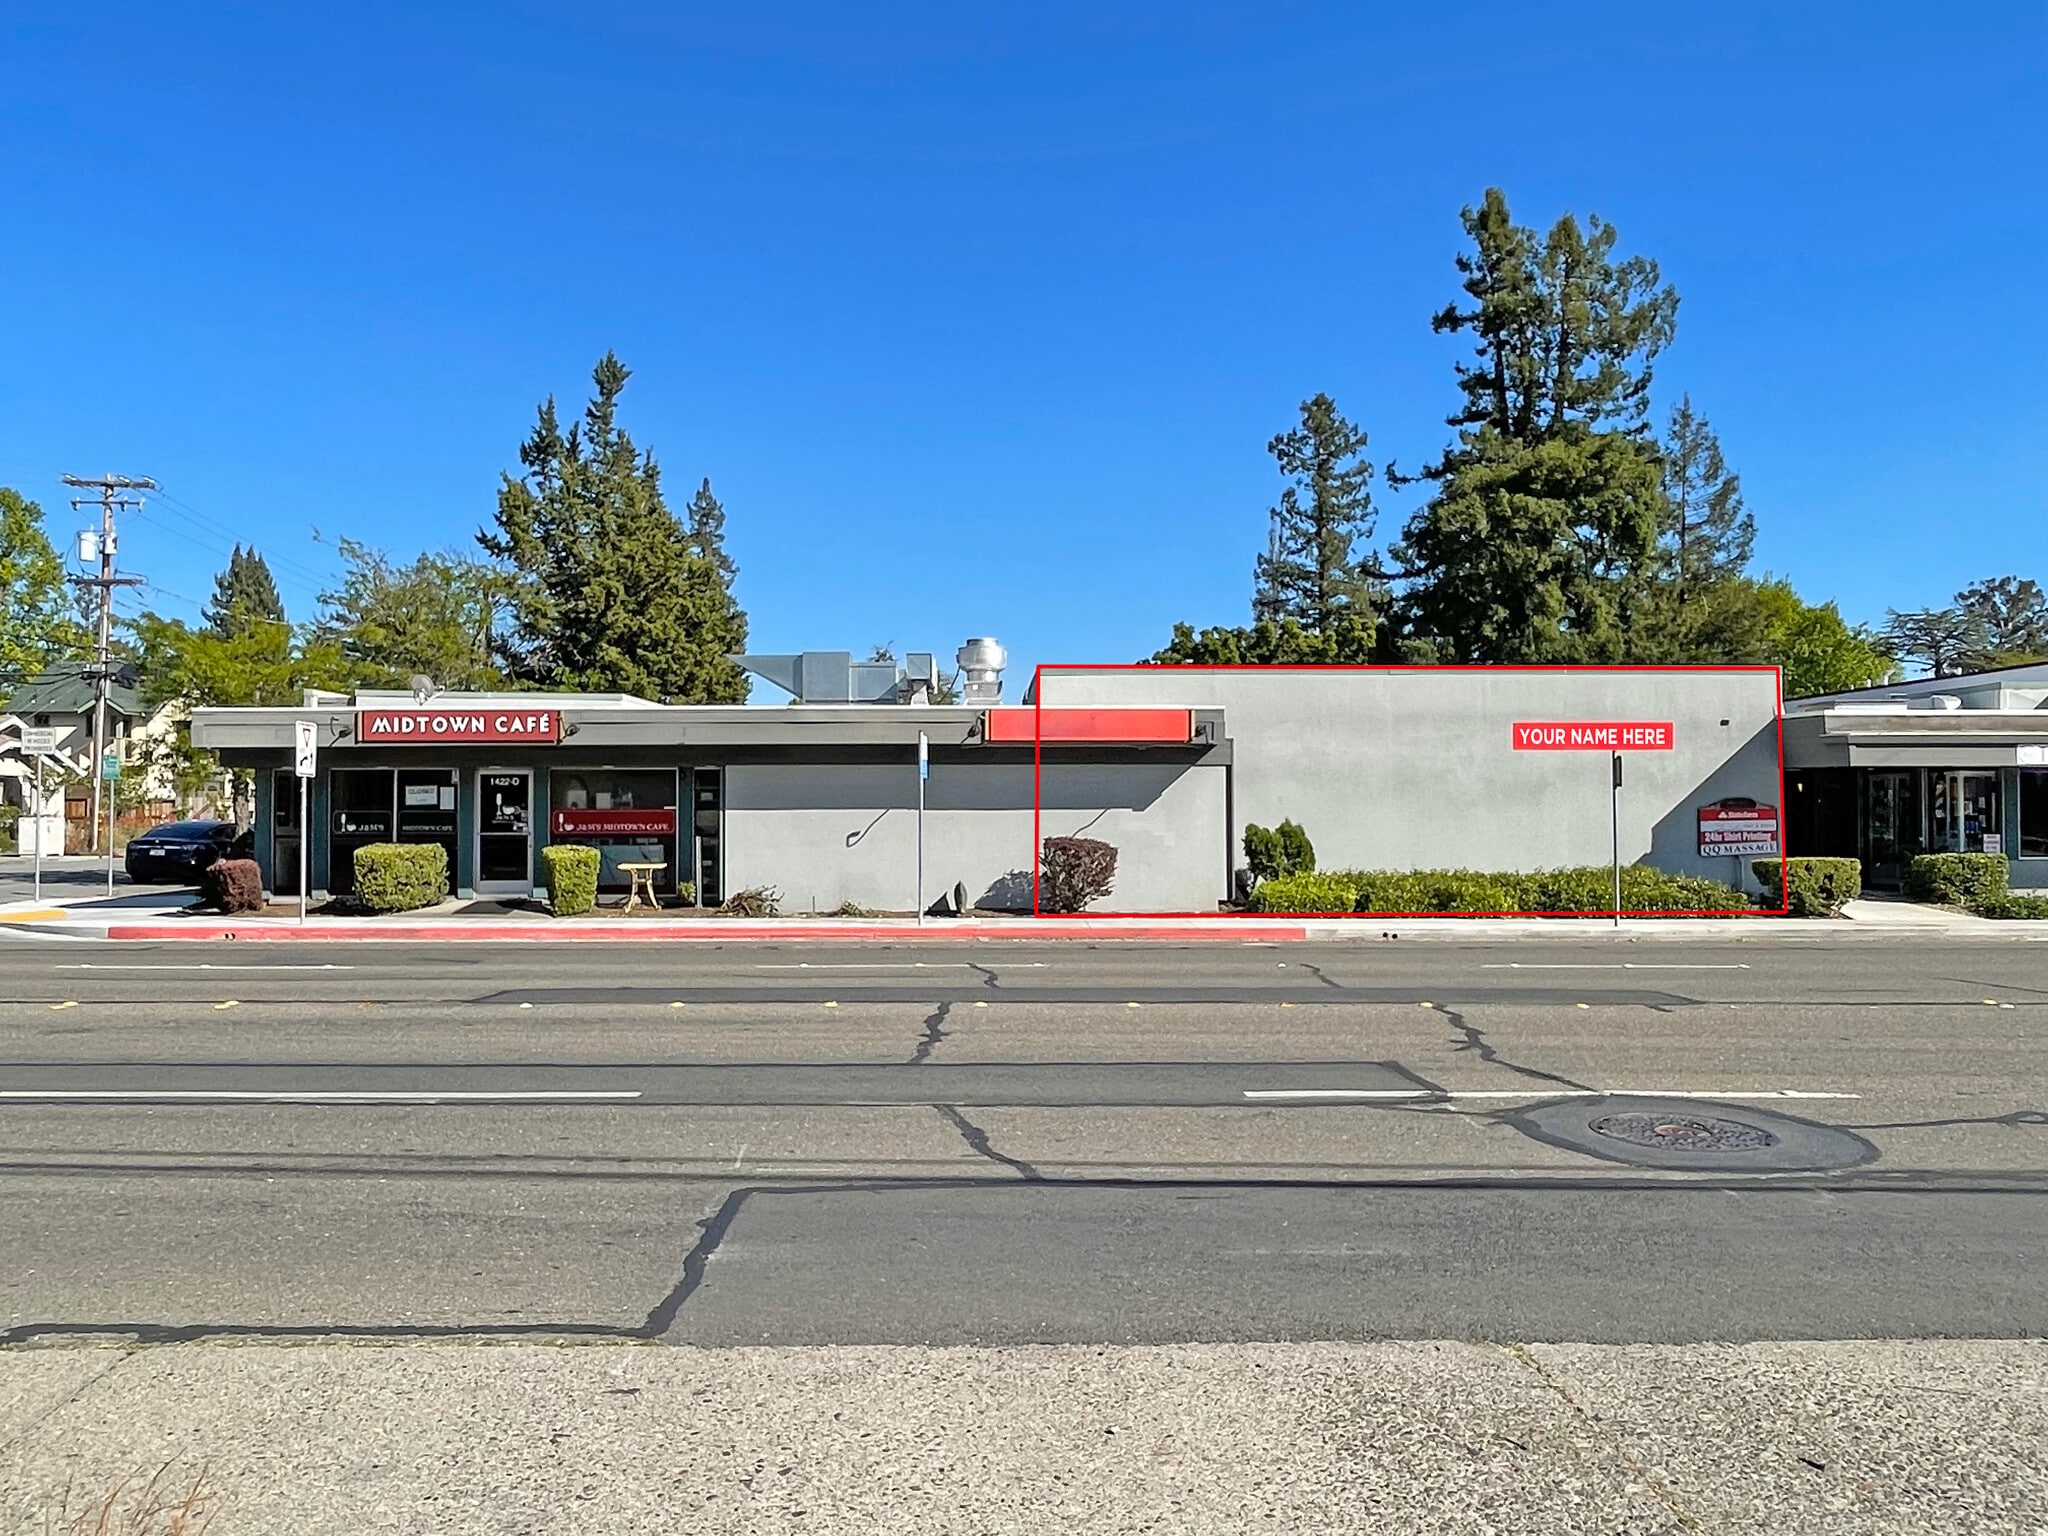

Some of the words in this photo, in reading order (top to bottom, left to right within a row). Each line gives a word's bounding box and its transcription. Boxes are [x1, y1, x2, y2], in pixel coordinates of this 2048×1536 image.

[371, 716, 484, 733] MIDTOWN
[494, 713, 550, 733] CAFÉ
[1702, 843, 1721, 856] QQ
[1723, 842, 1776, 853] MASSAGE
